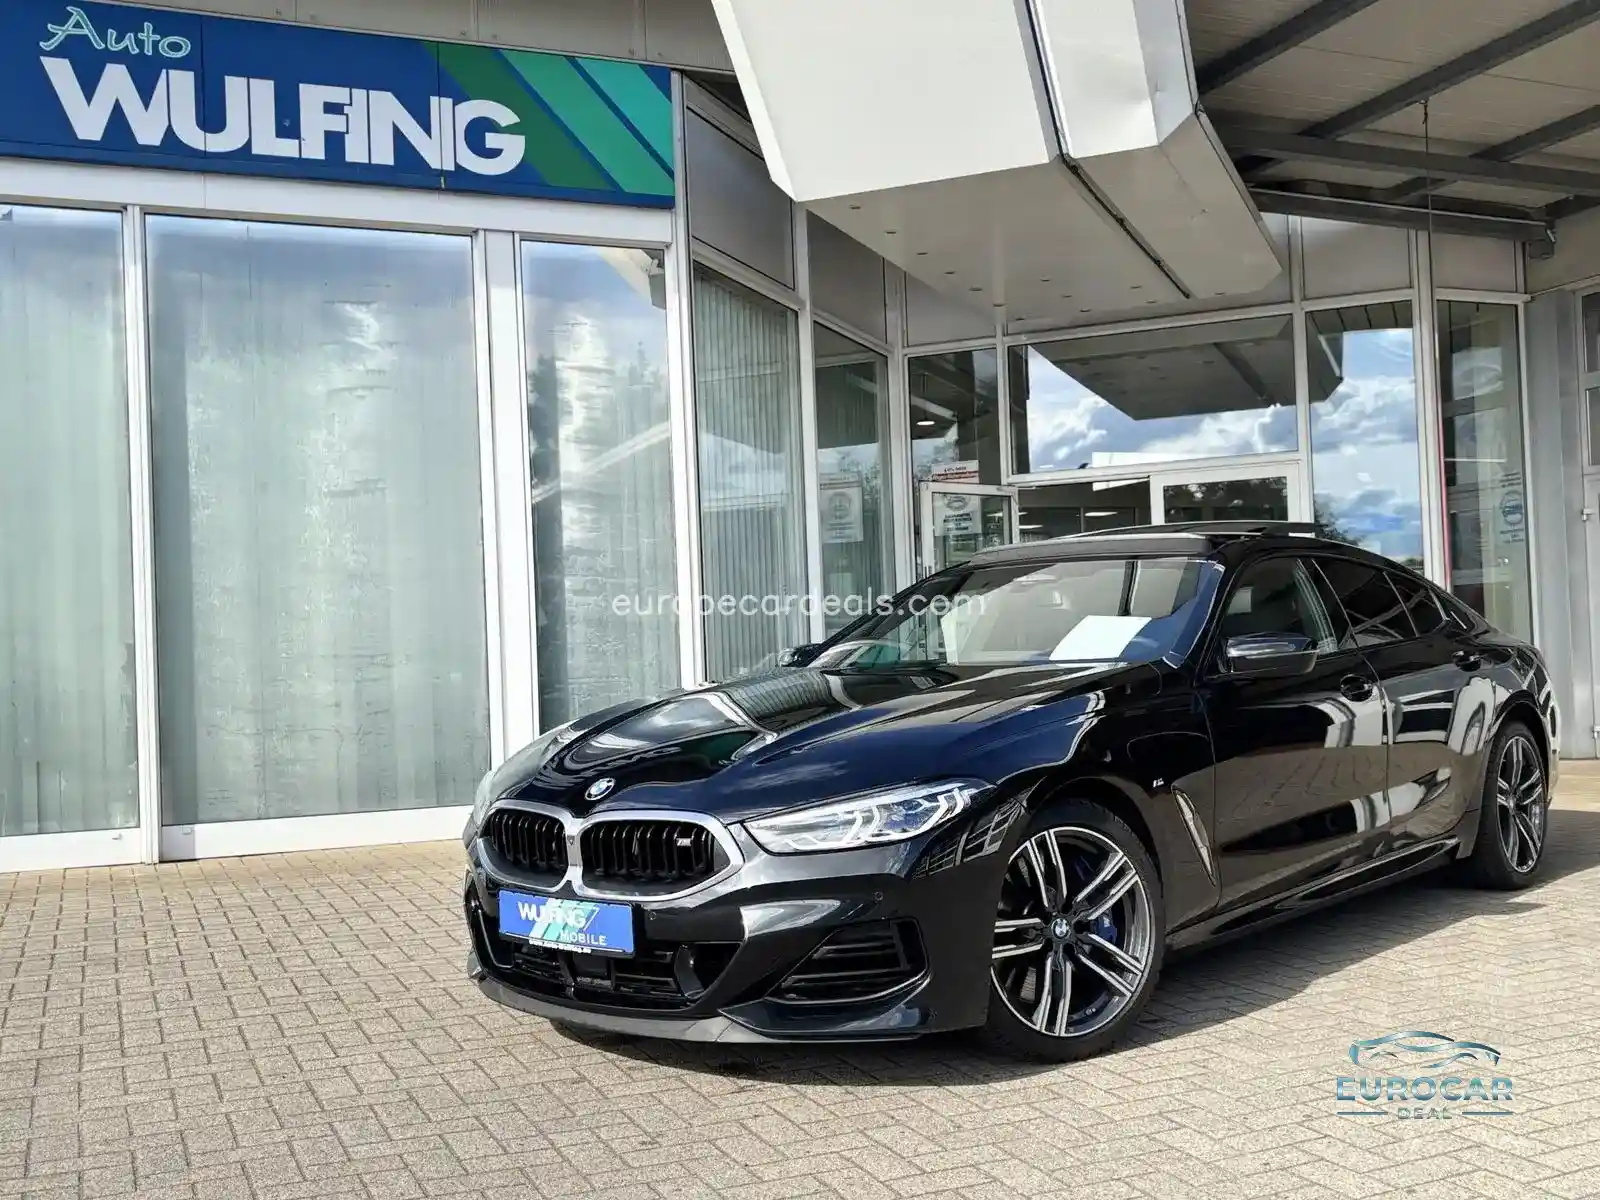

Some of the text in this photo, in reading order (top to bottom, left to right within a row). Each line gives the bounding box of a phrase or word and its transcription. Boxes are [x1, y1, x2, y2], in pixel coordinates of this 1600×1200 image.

[39, 6, 191, 58] Auto
[39, 56, 526, 176] WULFING
[560, 930, 608, 946] MOBILE
